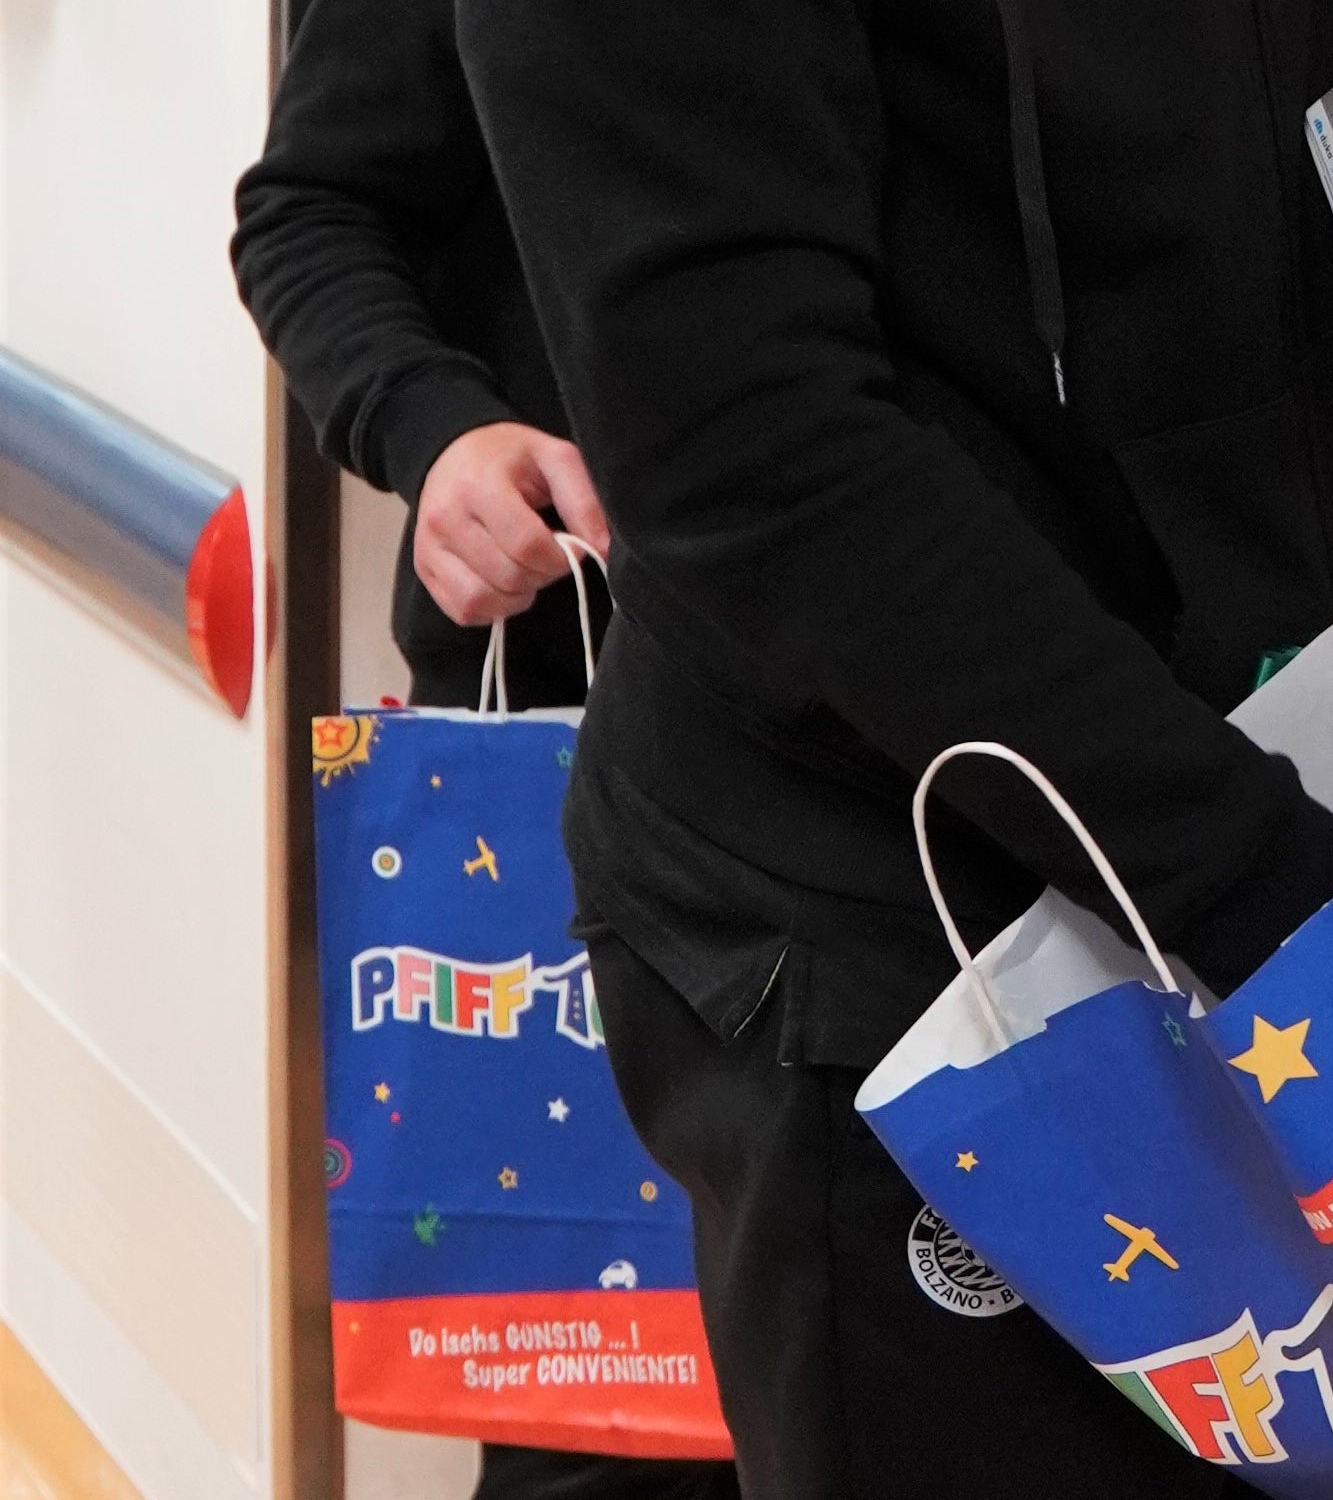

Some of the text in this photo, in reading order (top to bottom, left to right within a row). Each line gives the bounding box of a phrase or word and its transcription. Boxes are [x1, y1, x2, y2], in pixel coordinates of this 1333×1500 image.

[351, 945, 534, 1039] PFIFF
[915, 1247, 983, 1310] BOLZANO
[408, 1327, 437, 1357] Do
[463, 1353, 698, 1392] Super CONVENIENTE!
